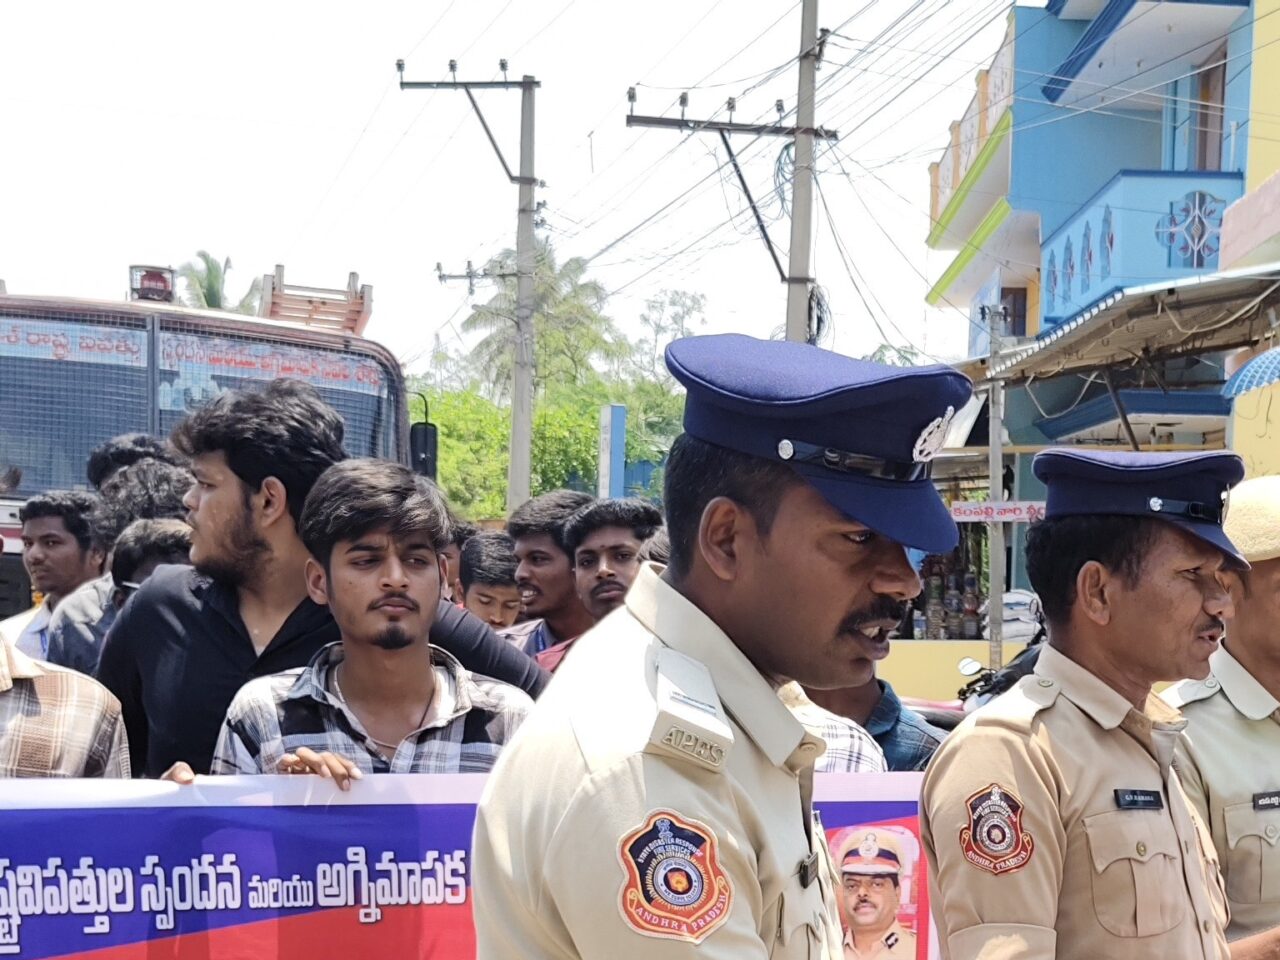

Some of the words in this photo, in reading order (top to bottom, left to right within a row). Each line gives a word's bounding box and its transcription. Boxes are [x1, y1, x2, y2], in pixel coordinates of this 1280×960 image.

[638, 844, 652, 864] STATE
[967, 851, 994, 869] ANDHRA
[996, 851, 1027, 869] PRADESH
[140, 854, 242, 930] స్పందన
[248, 875, 314, 908] మరియు
[317, 846, 467, 923] అగ్నిమాపక
[636, 907, 688, 932] ANDHRA
[692, 895, 727, 931] PRADESH
